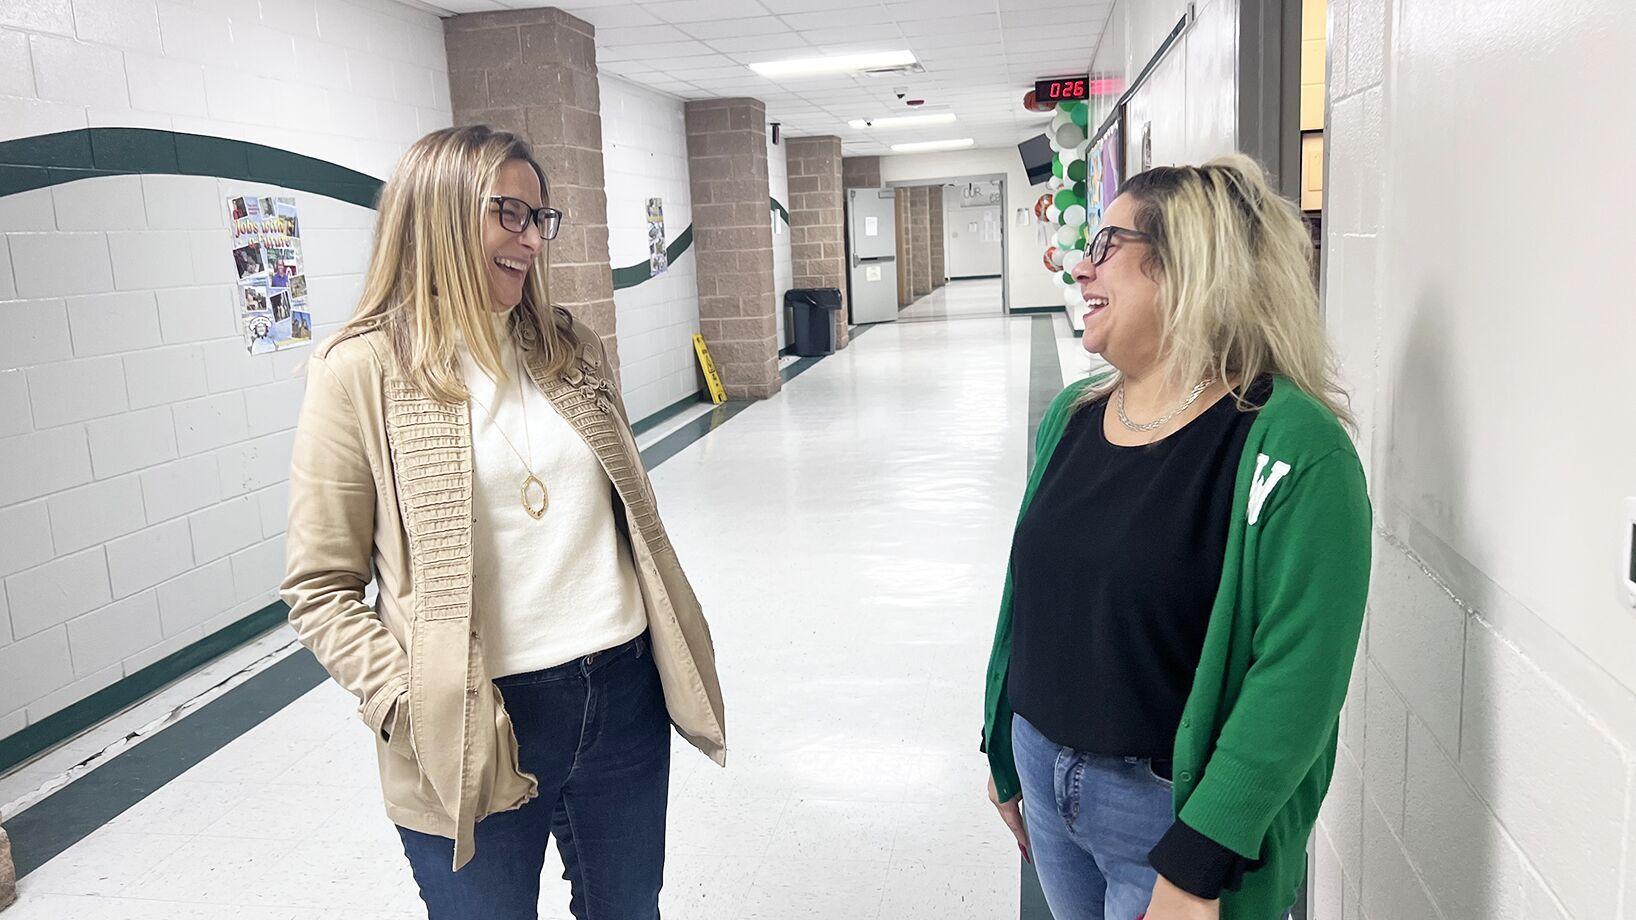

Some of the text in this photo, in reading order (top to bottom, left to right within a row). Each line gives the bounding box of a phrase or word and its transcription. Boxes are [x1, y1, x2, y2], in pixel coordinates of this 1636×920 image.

[235, 217, 285, 238] Jobs with
[1247, 453, 1291, 526] W
